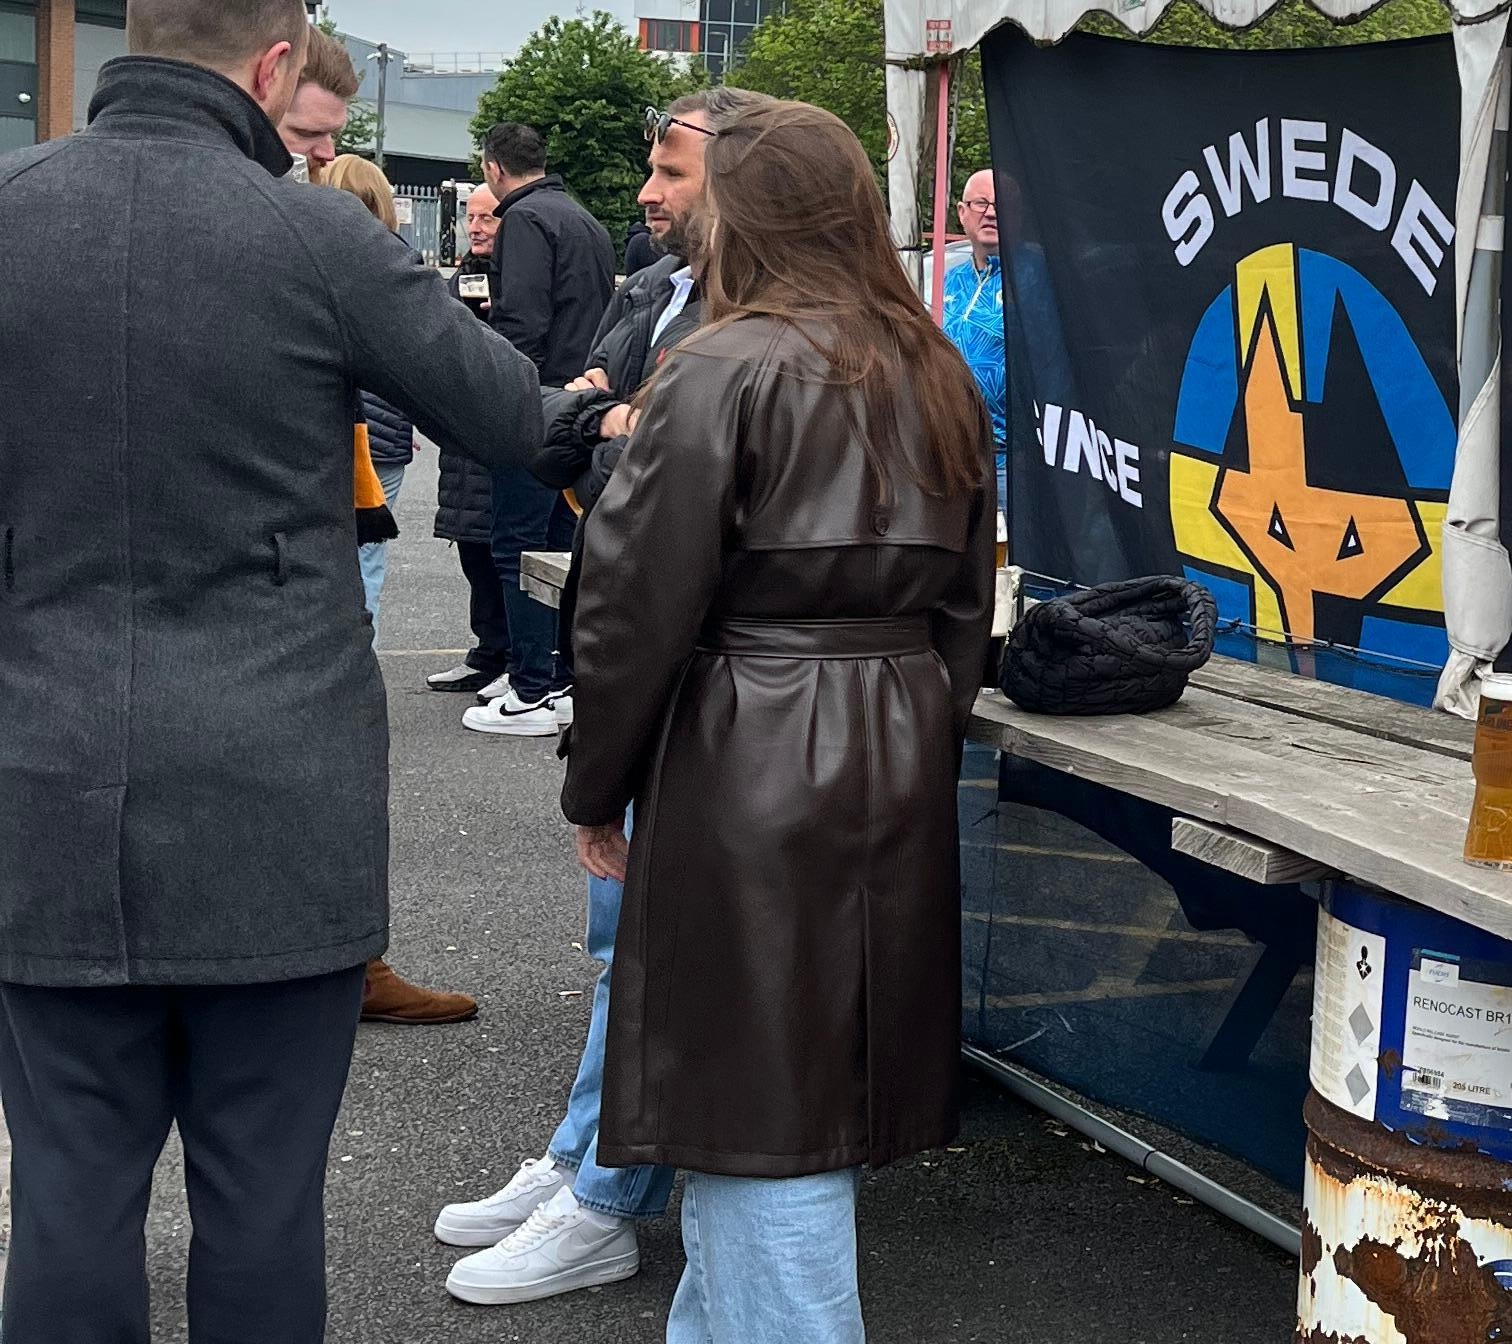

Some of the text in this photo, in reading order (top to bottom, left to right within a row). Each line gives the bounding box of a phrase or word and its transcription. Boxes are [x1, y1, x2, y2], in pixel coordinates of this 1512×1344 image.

[1161, 117, 1457, 297] SWEDE
[1032, 399, 1143, 509] INCE
[1413, 995, 1482, 1020] RENOCAST
[1467, 1084, 1491, 1095] LITRE
